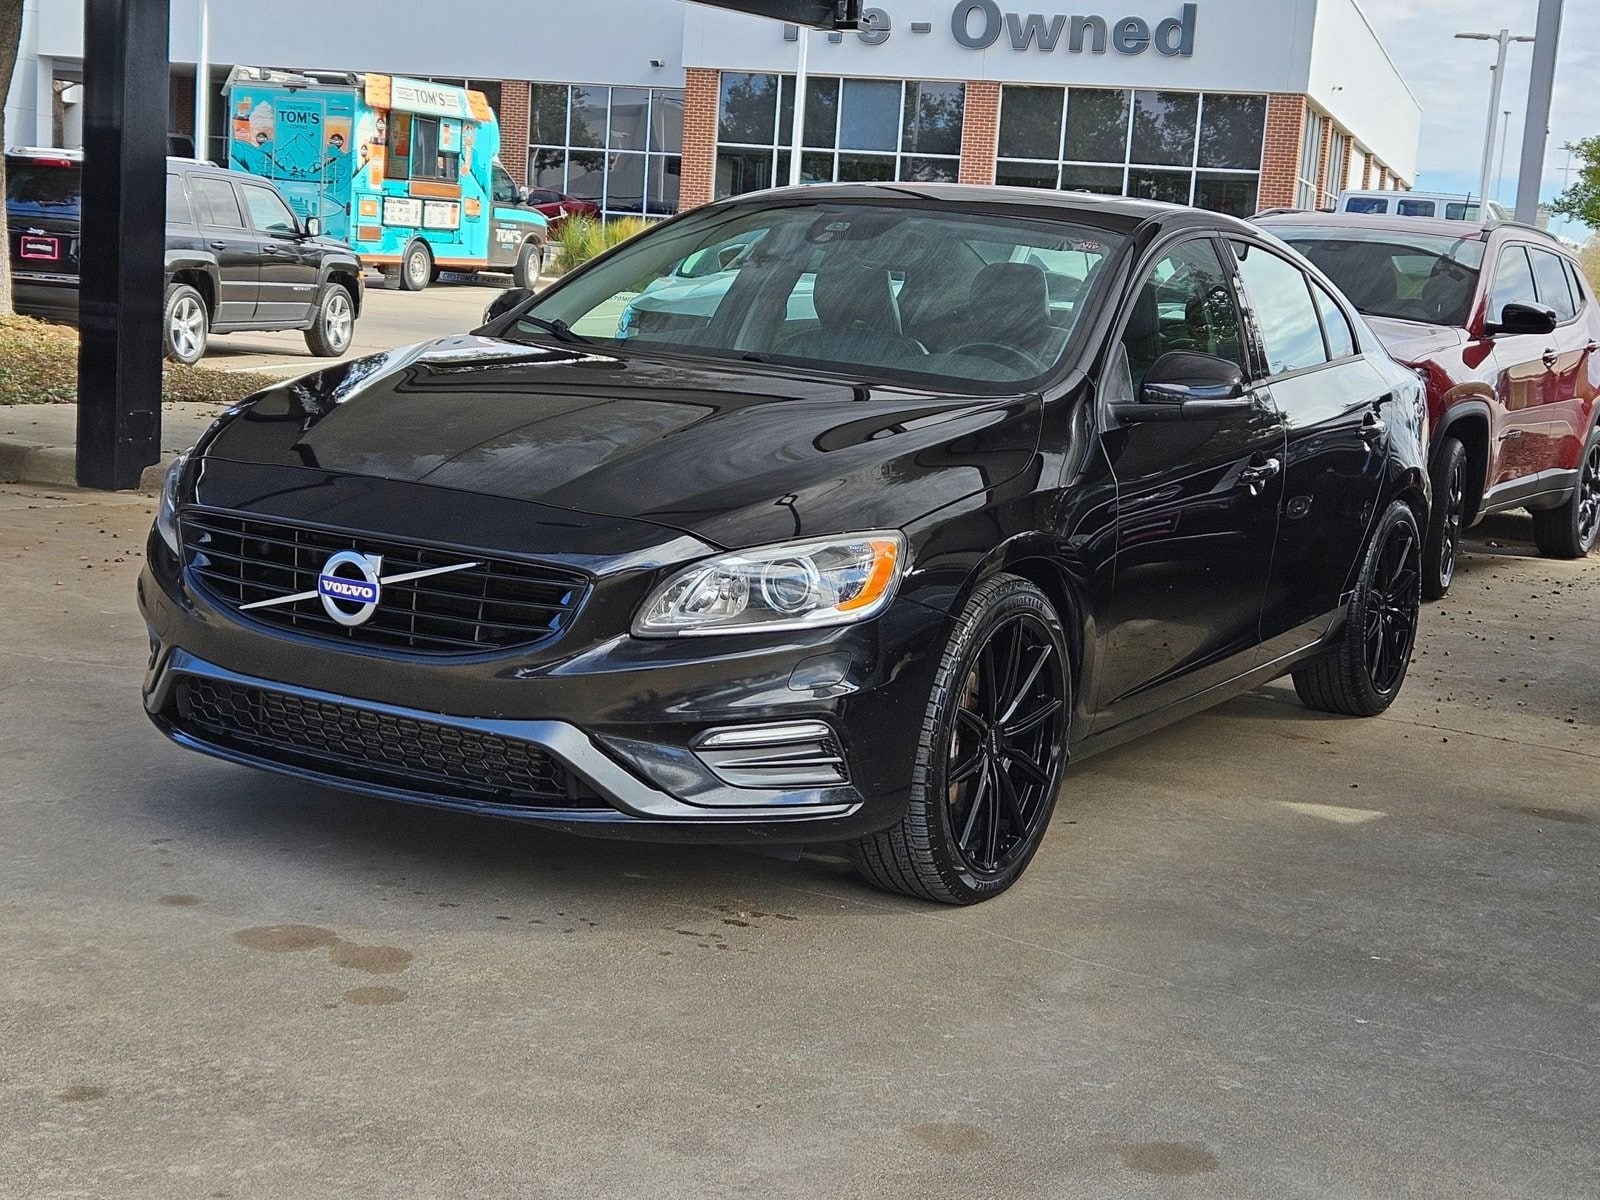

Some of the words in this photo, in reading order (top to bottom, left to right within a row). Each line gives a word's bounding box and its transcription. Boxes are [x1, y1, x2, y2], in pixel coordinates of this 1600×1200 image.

[950, 0, 1198, 56] Owned
[414, 89, 446, 106] TOM'S
[278, 110, 320, 125] TOM'S
[495, 228, 522, 243] TOM'S
[322, 580, 373, 598] VOLVO
